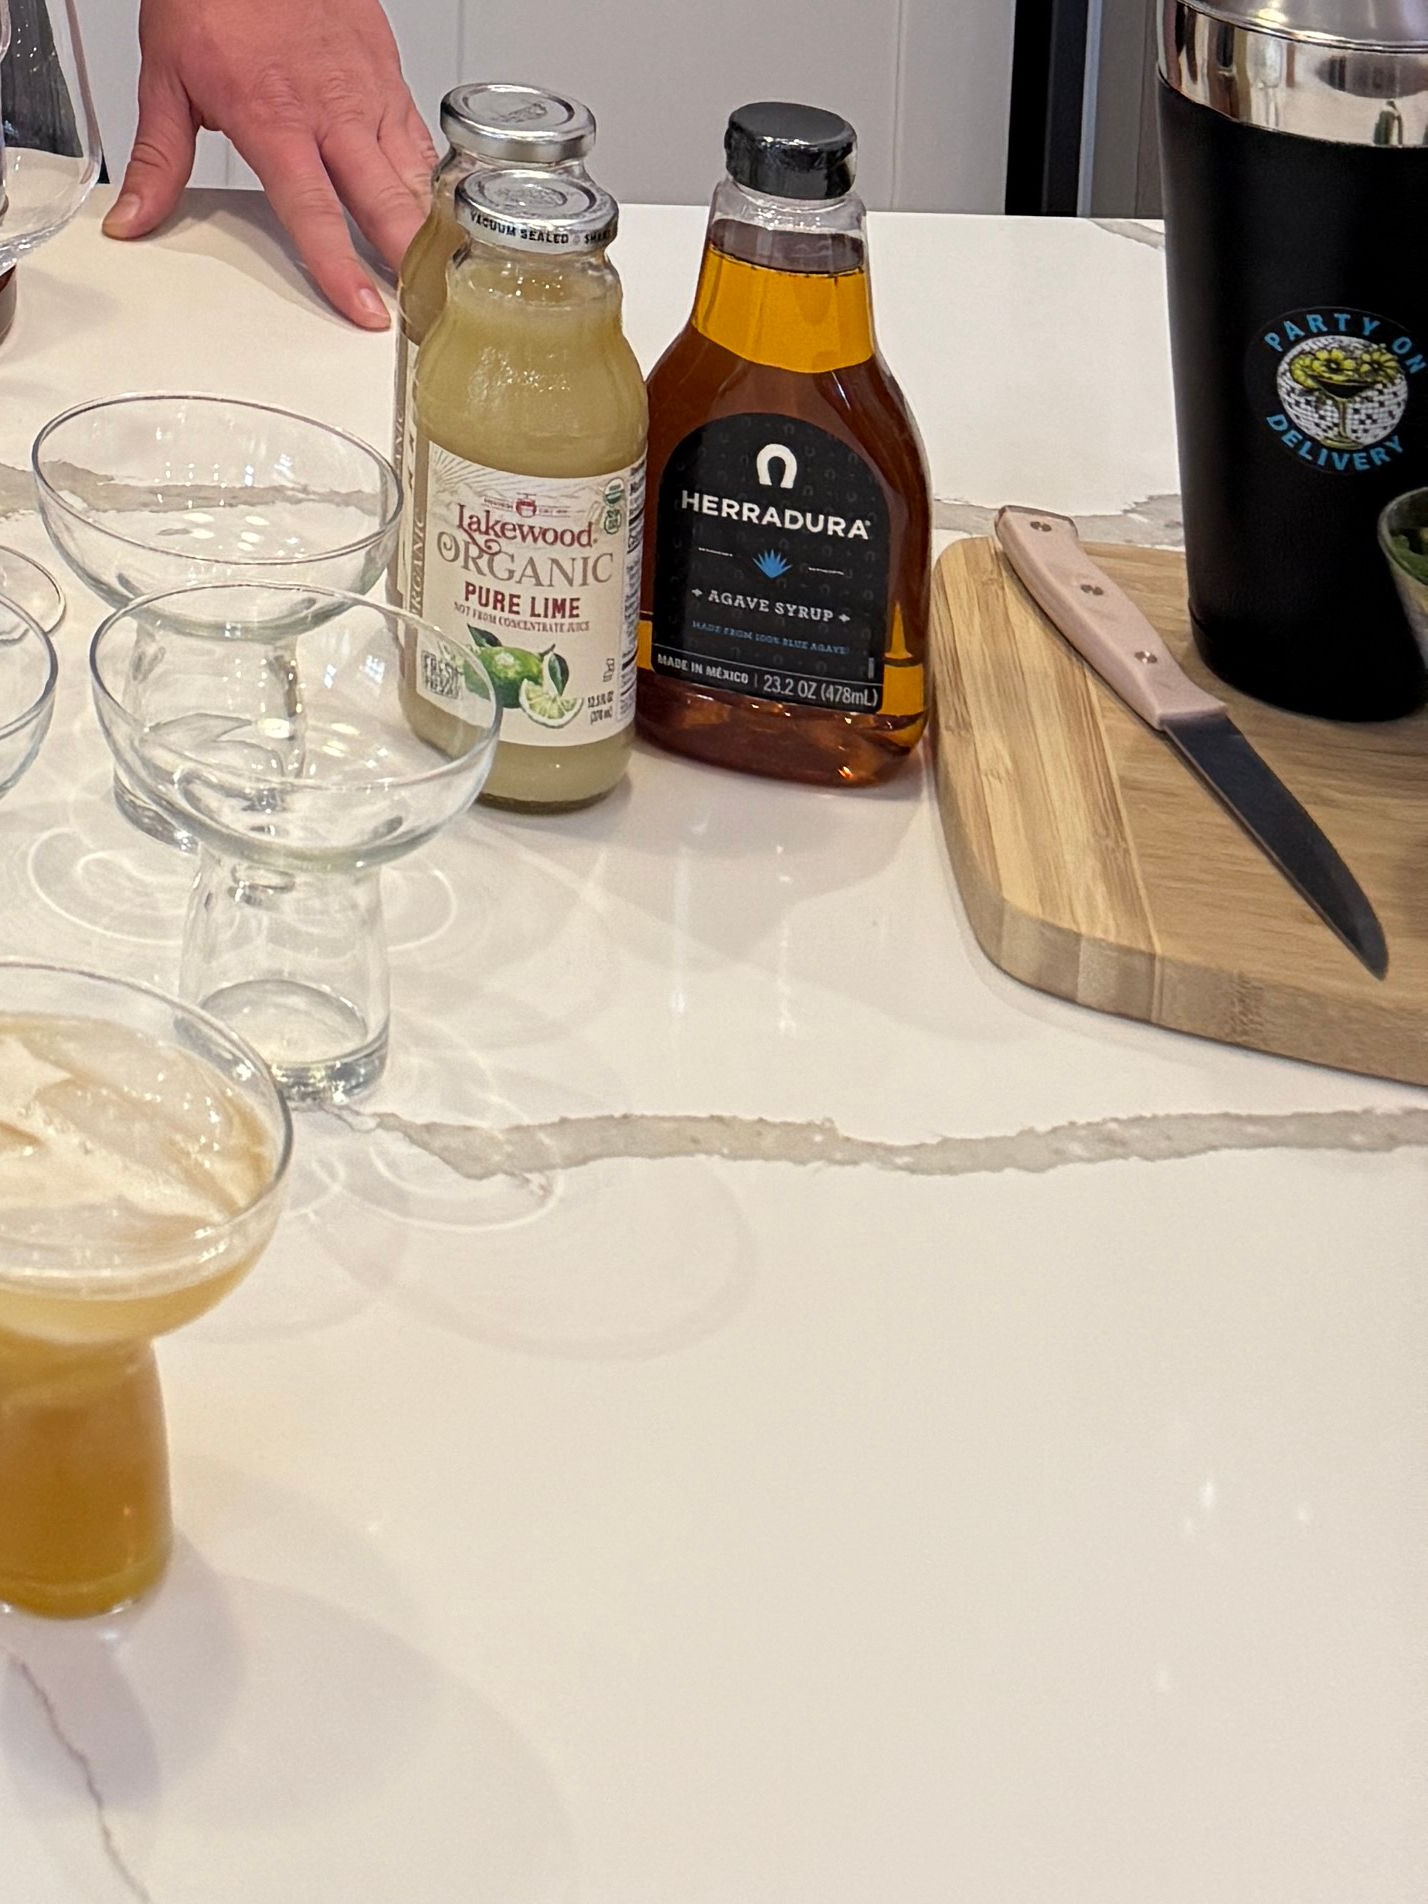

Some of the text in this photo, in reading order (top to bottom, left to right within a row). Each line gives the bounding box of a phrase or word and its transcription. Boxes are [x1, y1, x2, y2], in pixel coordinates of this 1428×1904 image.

[470, 212, 516, 236] VACUUM
[521, 229, 569, 244] SEALED
[1264, 313, 1427, 374] PARTY ON
[1266, 414, 1403, 471] DELIVERY
[457, 503, 594, 556] Lakewood
[682, 490, 869, 540] HERRADURA
[437, 531, 613, 587] ORGANIC
[465, 581, 581, 619] PURE LIME
[473, 608, 496, 624] FROM
[499, 616, 565, 632] CONCENTRATE
[708, 589, 833, 622] AGAVE SYRUP
[692, 620, 721, 633] MADE
[724, 628, 753, 641] FROM
[782, 638, 808, 649] BLUE
[657, 653, 879, 707] MADE IN MÉXICO 23.2 OZ (478mL)
